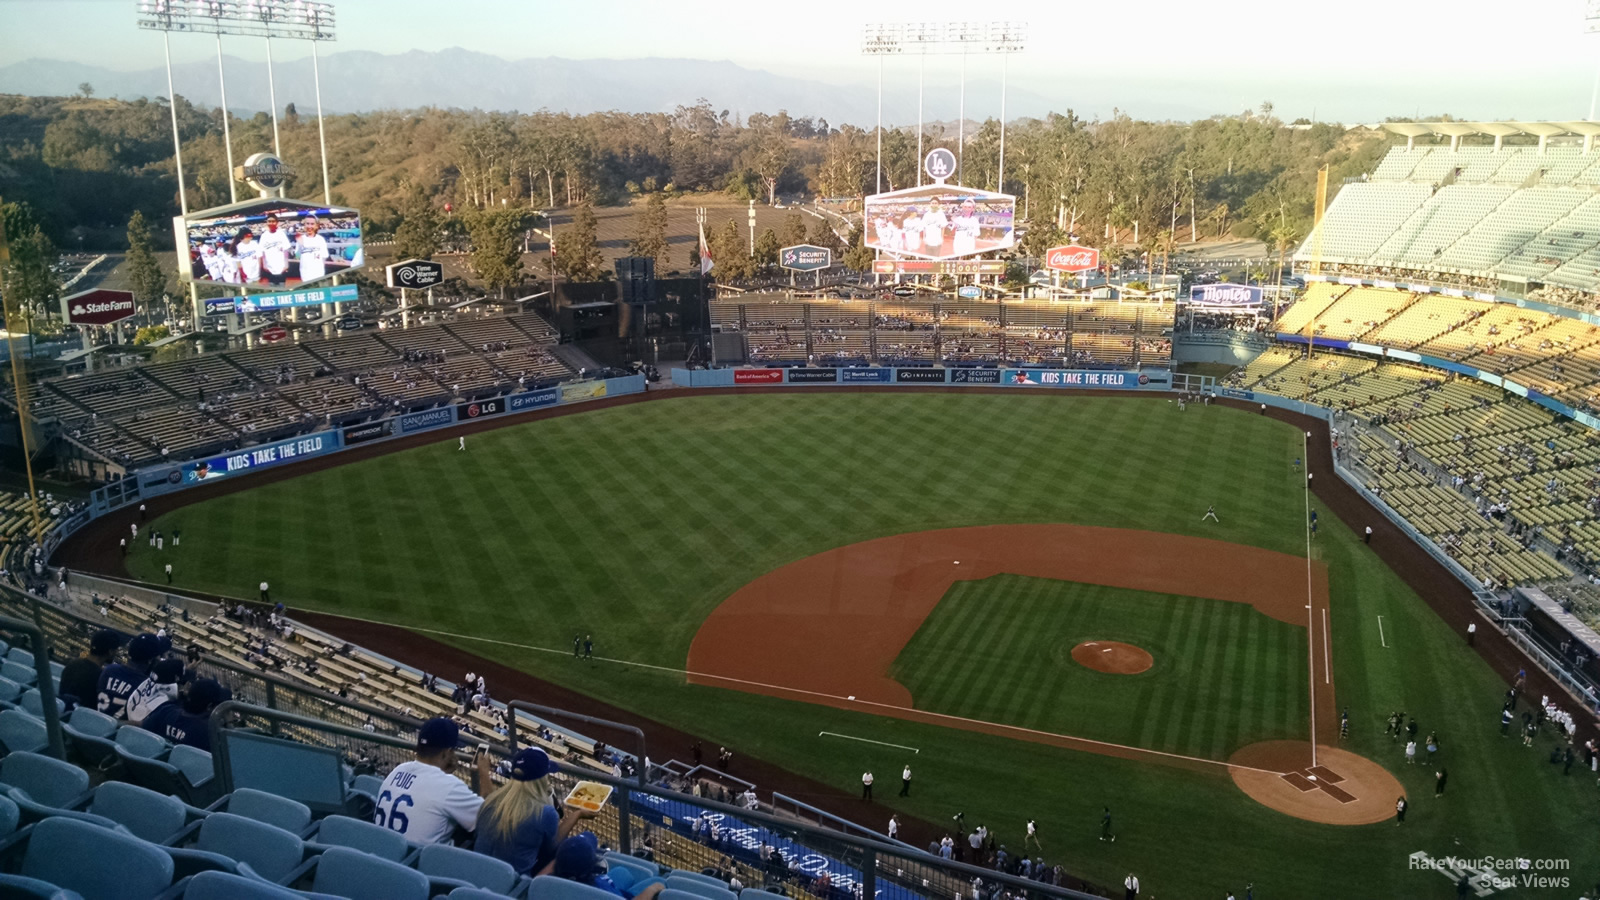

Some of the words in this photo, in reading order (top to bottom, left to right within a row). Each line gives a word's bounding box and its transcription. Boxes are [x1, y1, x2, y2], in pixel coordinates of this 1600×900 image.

[932, 154, 948, 174] LA
[416, 276, 436, 284] Cable
[260, 296, 275, 307] KIDS
[277, 295, 293, 306] TAKE
[294, 293, 306, 304] THE
[308, 291, 325, 303] FIELD
[1203, 286, 1252, 303] Montejo
[1041, 372, 1060, 384] KIDS
[1063, 372, 1083, 384] TAKE
[1085, 373, 1099, 385] THE
[1102, 373, 1124, 385] FIELD
[525, 393, 556, 404] HYUNDAI
[482, 403, 496, 414] LG
[402, 416, 418, 426] SAN
[422, 411, 450, 422] MANUEL
[226, 454, 249, 471] KIDS
[252, 448, 276, 464] TAKE
[278, 443, 296, 459] THE
[297, 437, 322, 455] FIELD
[106, 677, 132, 695] KEMP
[391, 772, 417, 790] PUIG
[374, 790, 414, 834] 66
